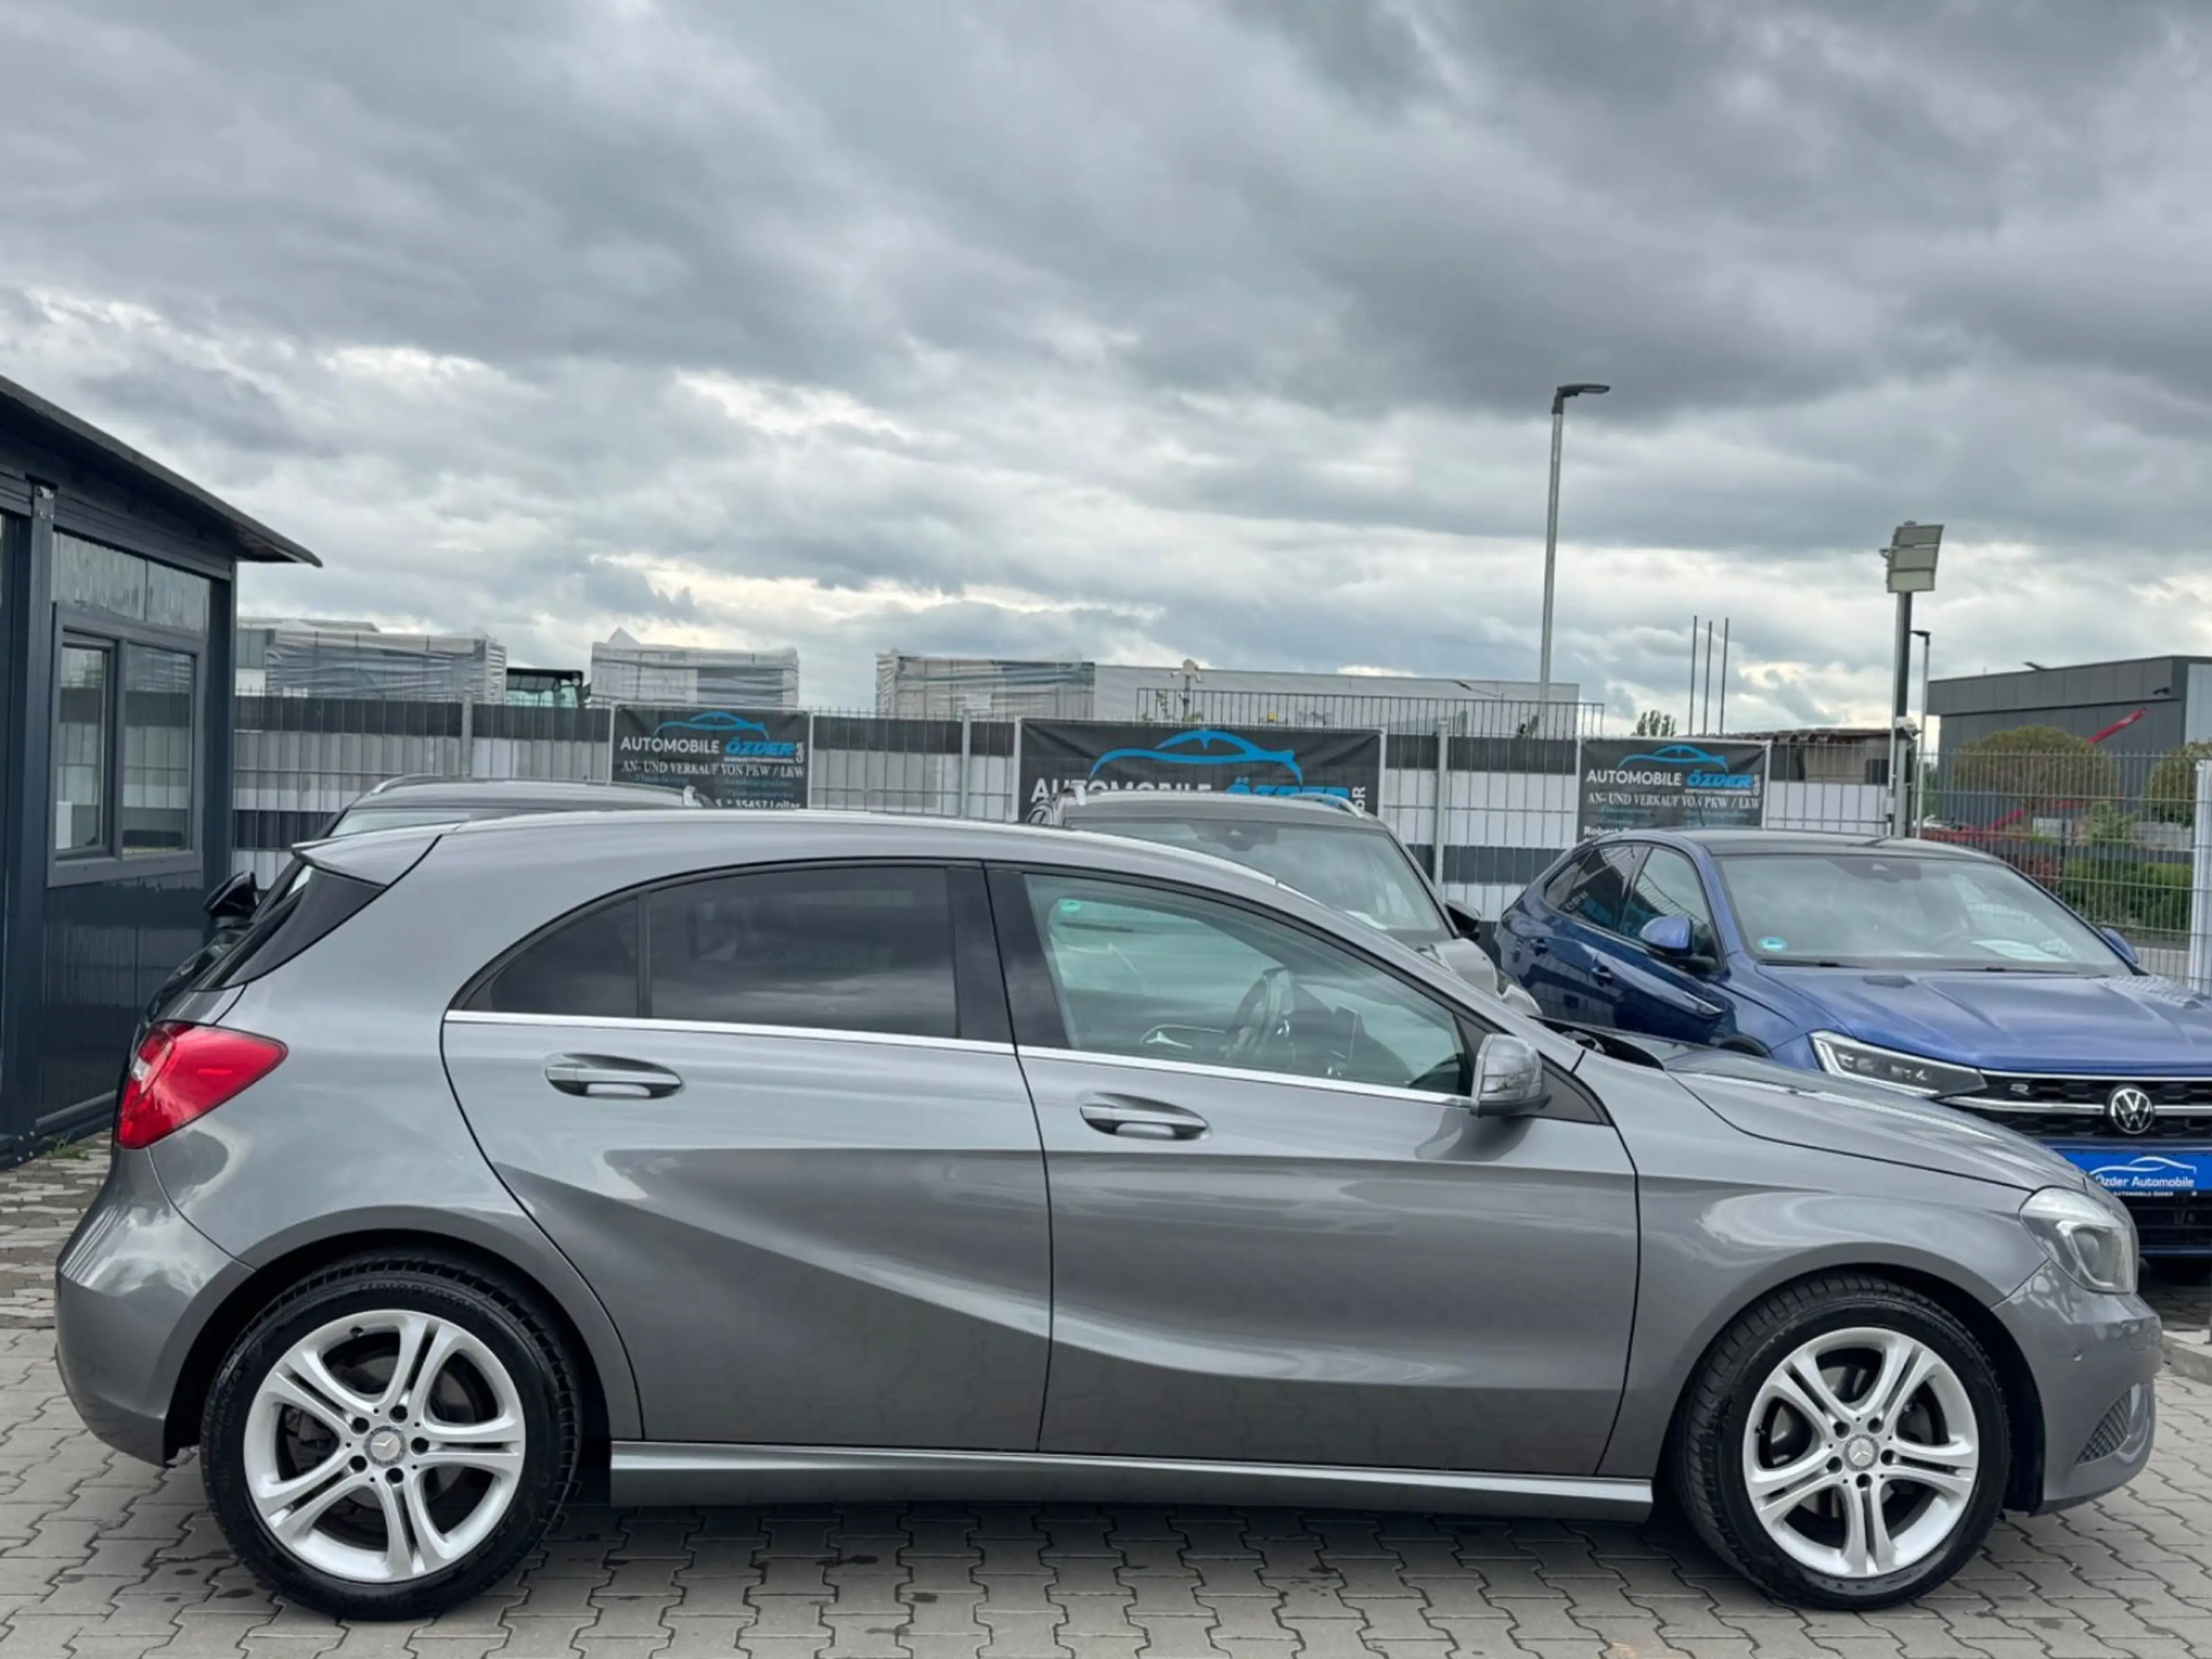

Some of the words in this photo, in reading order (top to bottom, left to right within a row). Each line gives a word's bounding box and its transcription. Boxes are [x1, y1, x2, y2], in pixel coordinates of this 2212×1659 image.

[620, 736, 719, 754] AUTOMOBILE
[725, 736, 796, 756] ÖZDER
[644, 760, 668, 774] UND
[671, 762, 719, 775] VERKAUF
[721, 763, 743, 777] VON
[746, 764, 771, 777] PKW
[781, 765, 805, 778] LKW
[1586, 768, 1682, 786] AUTOMOBILE
[1609, 792, 1632, 806] UND
[1634, 793, 1680, 807] VERKAUF
[1705, 796, 1728, 809] PKW
[1738, 797, 1762, 809] LKW
[2131, 1176, 2195, 1188] Automobile
